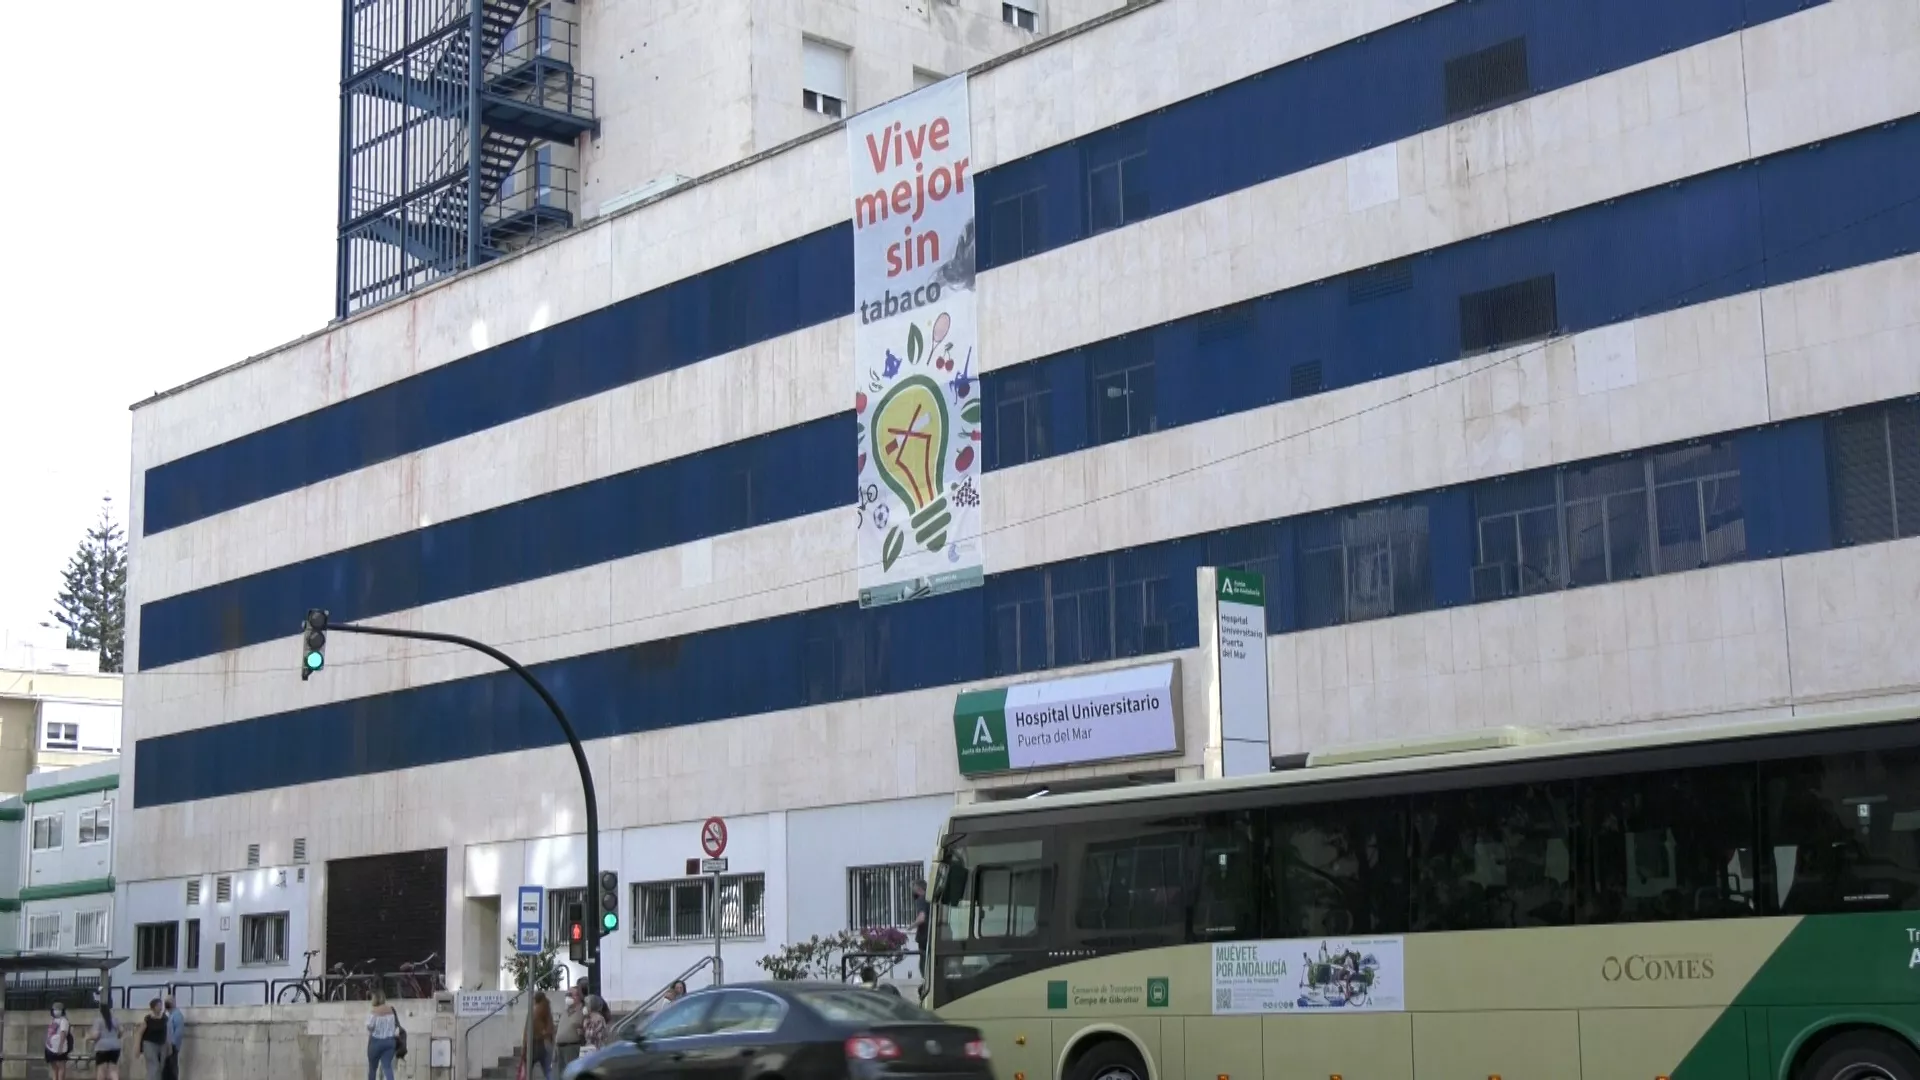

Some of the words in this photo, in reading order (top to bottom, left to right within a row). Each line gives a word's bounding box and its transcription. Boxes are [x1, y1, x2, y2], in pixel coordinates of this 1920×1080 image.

[865, 116, 950, 174] Vive
[855, 156, 969, 229] mejor
[886, 226, 940, 278] sin
[860, 281, 941, 325] tabaco
[1221, 614, 1248, 625] Hospital
[1222, 626, 1263, 639] Universitario
[1222, 637, 1244, 648] Puerta
[1222, 648, 1232, 658] del
[1234, 650, 1247, 659] Mar
[1016, 704, 1069, 728] Hospital
[1072, 695, 1160, 720] Universitario
[1017, 730, 1051, 747] Puerta
[1054, 728, 1070, 744] del
[1072, 728, 1092, 740] Mar
[1216, 944, 1258, 961] MUÉVETE
[1216, 963, 1233, 977] POR
[1236, 958, 1287, 976] ANDALUCÍA
[1099, 995, 1107, 1004] de
